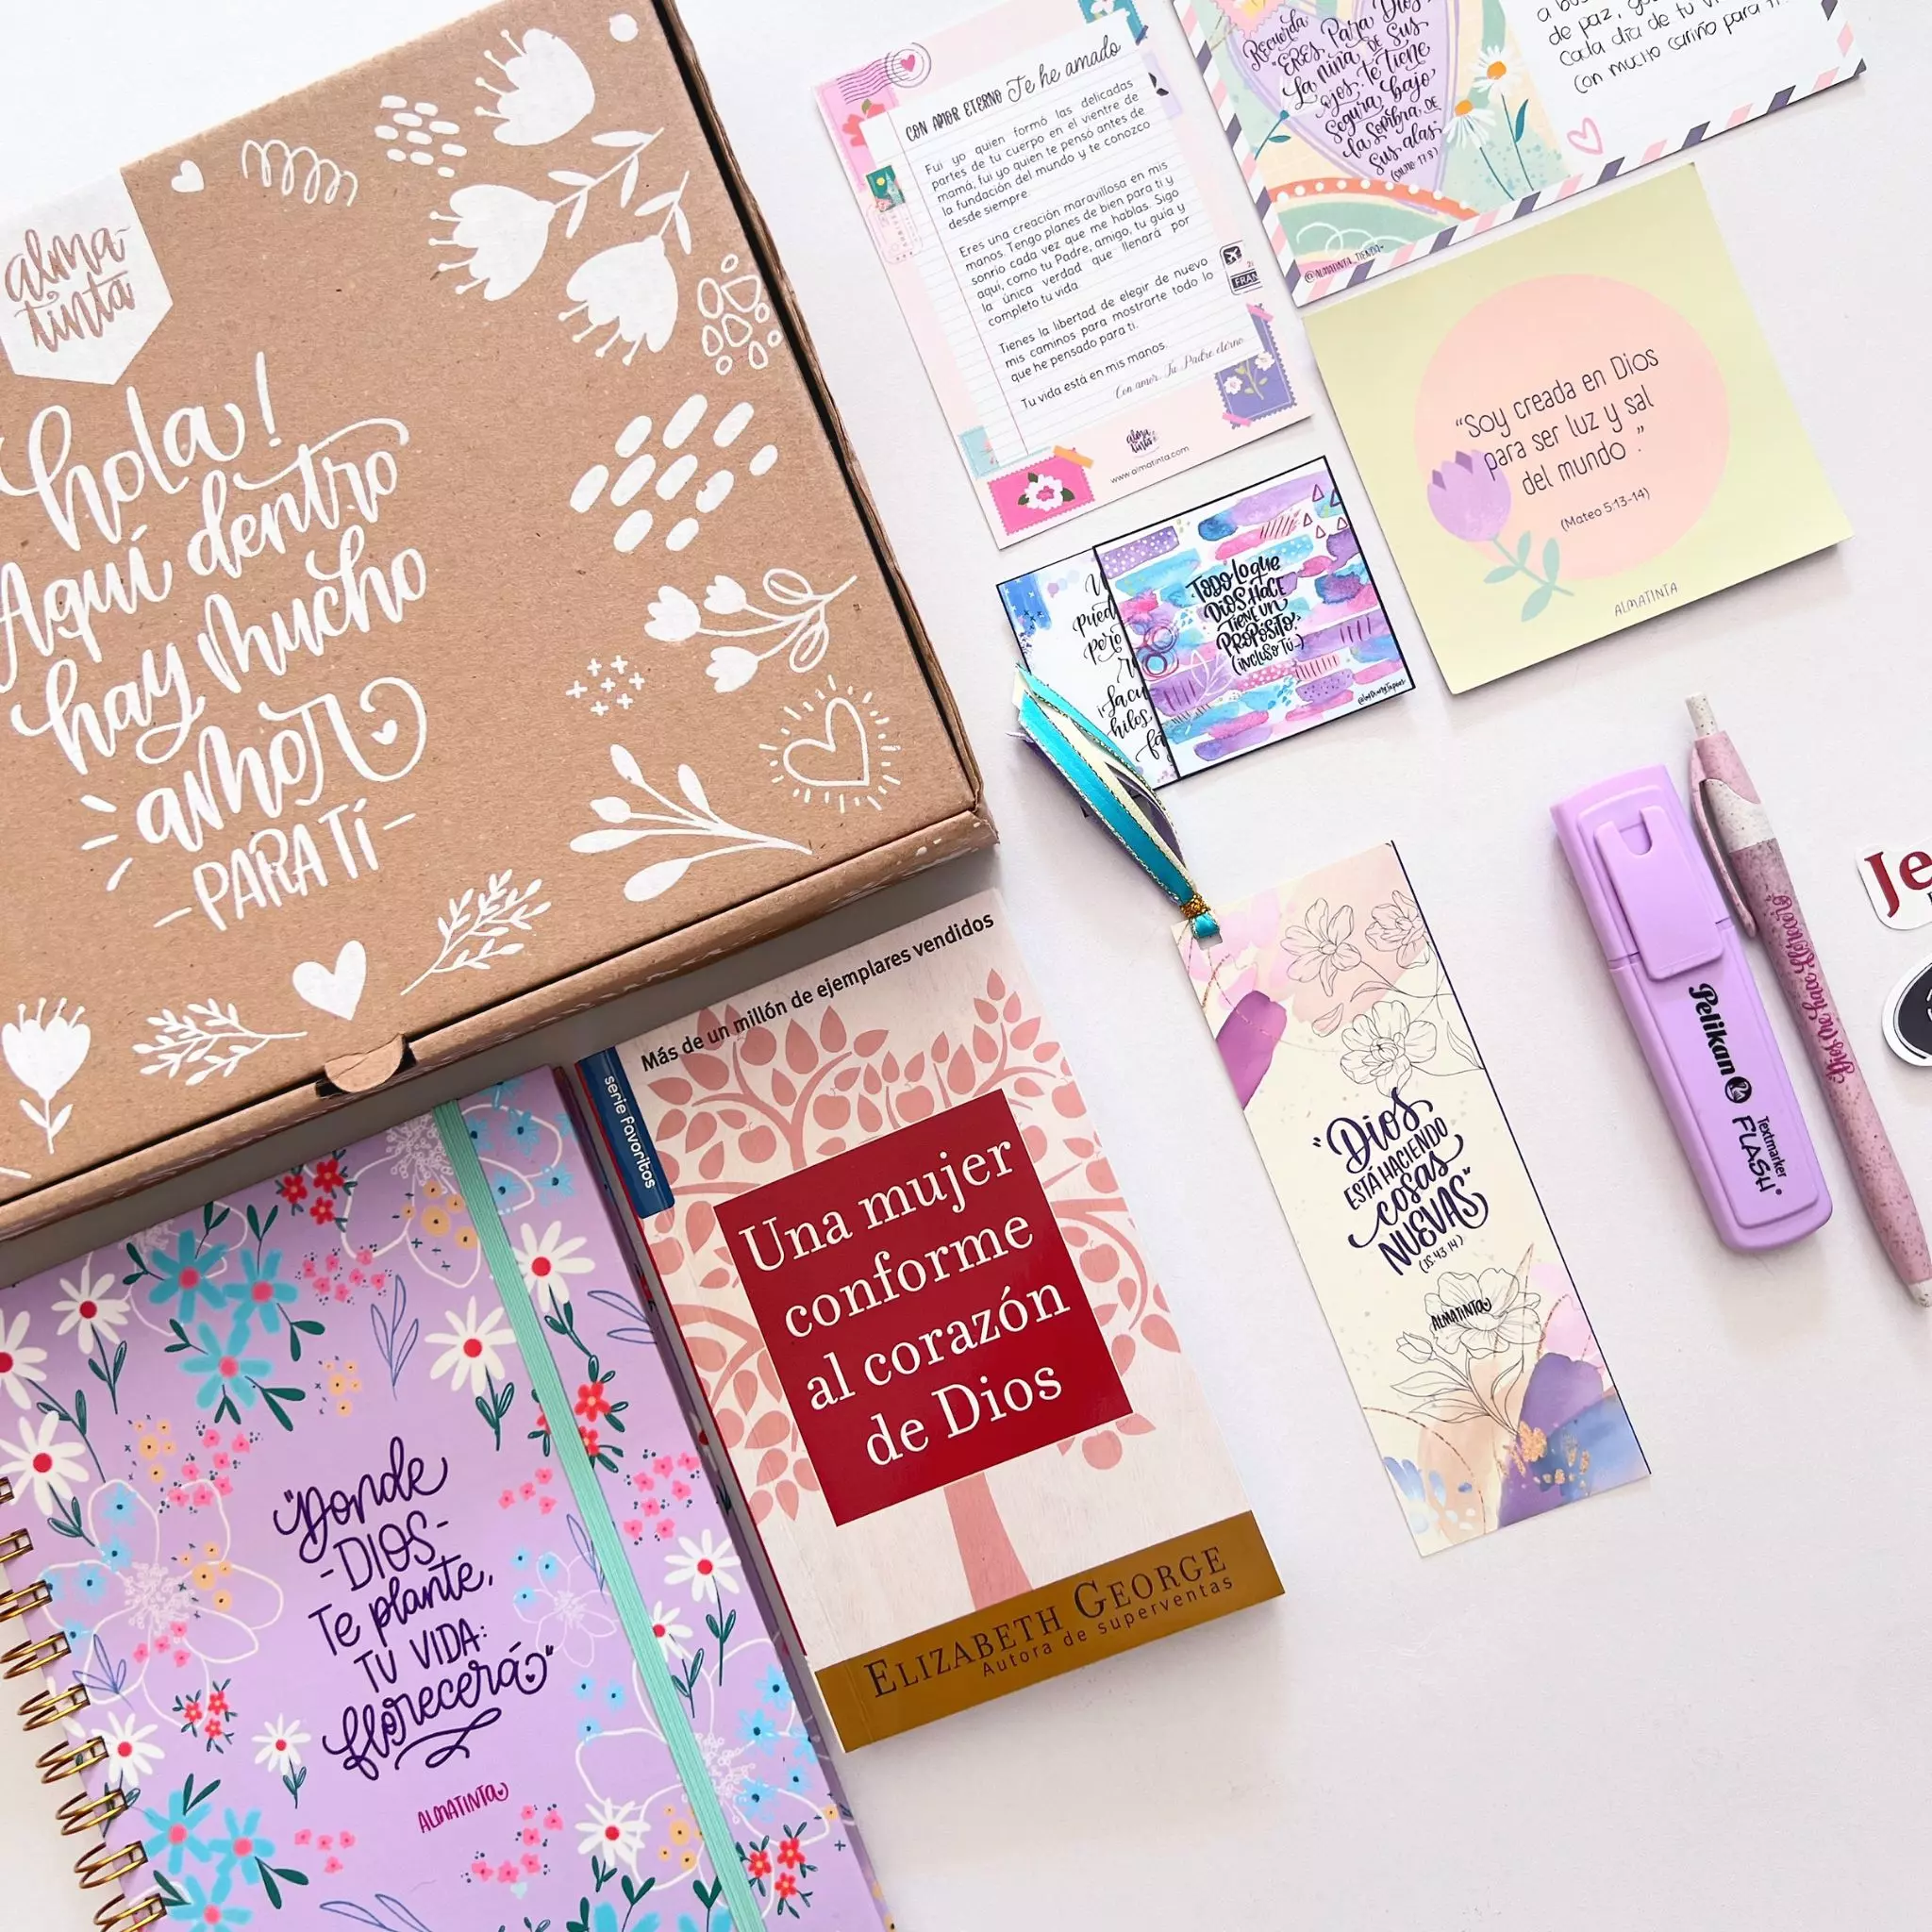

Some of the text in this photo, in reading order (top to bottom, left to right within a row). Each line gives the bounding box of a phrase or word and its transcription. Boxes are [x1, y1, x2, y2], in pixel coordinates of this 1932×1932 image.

[1548, 25, 1573, 46] de
[1647, 12, 1670, 31] de
[1668, 21, 1717, 52] cariño
[1723, 3, 1760, 35] para
[906, 34, 1122, 142] CON AMOR ETERNO Te he amado
[924, 80, 1134, 175] Fui yo quien formó las delicadas
[1379, 68, 1436, 103] bajo
[931, 93, 1139, 192] partes de tu cuerpo en el vientre de
[941, 121, 1151, 217] la fundación del mundo y te conozco
[977, 174, 993, 185] fui
[995, 167, 1010, 180] yo
[1013, 152, 1044, 171] quien
[1045, 145, 1058, 156] te
[1060, 128, 1094, 152] pensó
[1096, 115, 1128, 134] antes
[1130, 108, 1145, 119] de
[958, 162, 1168, 258] Eres una creación maravillosa en mis
[5, 225, 130, 303] alma
[13, 271, 134, 353] tinta
[1021, 397, 1037, 408] Tu
[1037, 387, 1062, 403] vida
[1064, 374, 1088, 391] está
[1090, 369, 1105, 380] en
[1105, 359, 1125, 374] mis
[1513, 379, 1576, 420] creada
[1582, 369, 1607, 391] en
[1610, 348, 1659, 380] Dios
[1110, 445, 1190, 483] www.almatinta.com
[1483, 384, 1655, 482] para ser luz y sal
[1522, 464, 1554, 495] del
[1560, 487, 1651, 532] (Mateo 5:13-14)
[0, 416, 410, 695] Aquí dentro
[1614, 581, 1679, 618] ALMATINTA
[11, 641, 206, 775] hay
[136, 675, 428, 854] amor
[641, 913, 994, 1073] Más de un millón de ejemplares vendidos
[1689, 983, 1736, 1076] Pelikan
[605, 1075, 656, 1189] serie favoritos
[1377, 1117, 1449, 1186] HACIENDO
[1757, 1115, 1787, 1178] Textmarker
[739, 1140, 1013, 1272] Una mujer
[1348, 1134, 1464, 1248] cosas
[785, 1214, 1033, 1339] conforme
[1431, 1296, 1492, 1331] ALMATINTA
[806, 1283, 1071, 1410] al corazón
[865, 1366, 1062, 1466] de Dios
[308, 1604, 361, 1656] Te
[863, 1545, 1226, 1699] ELIZABETH GEORGE
[982, 1575, 1233, 1677] Autora de superventas
[354, 1649, 397, 1693] TU
[417, 1782, 509, 1834] ALMATINTA
